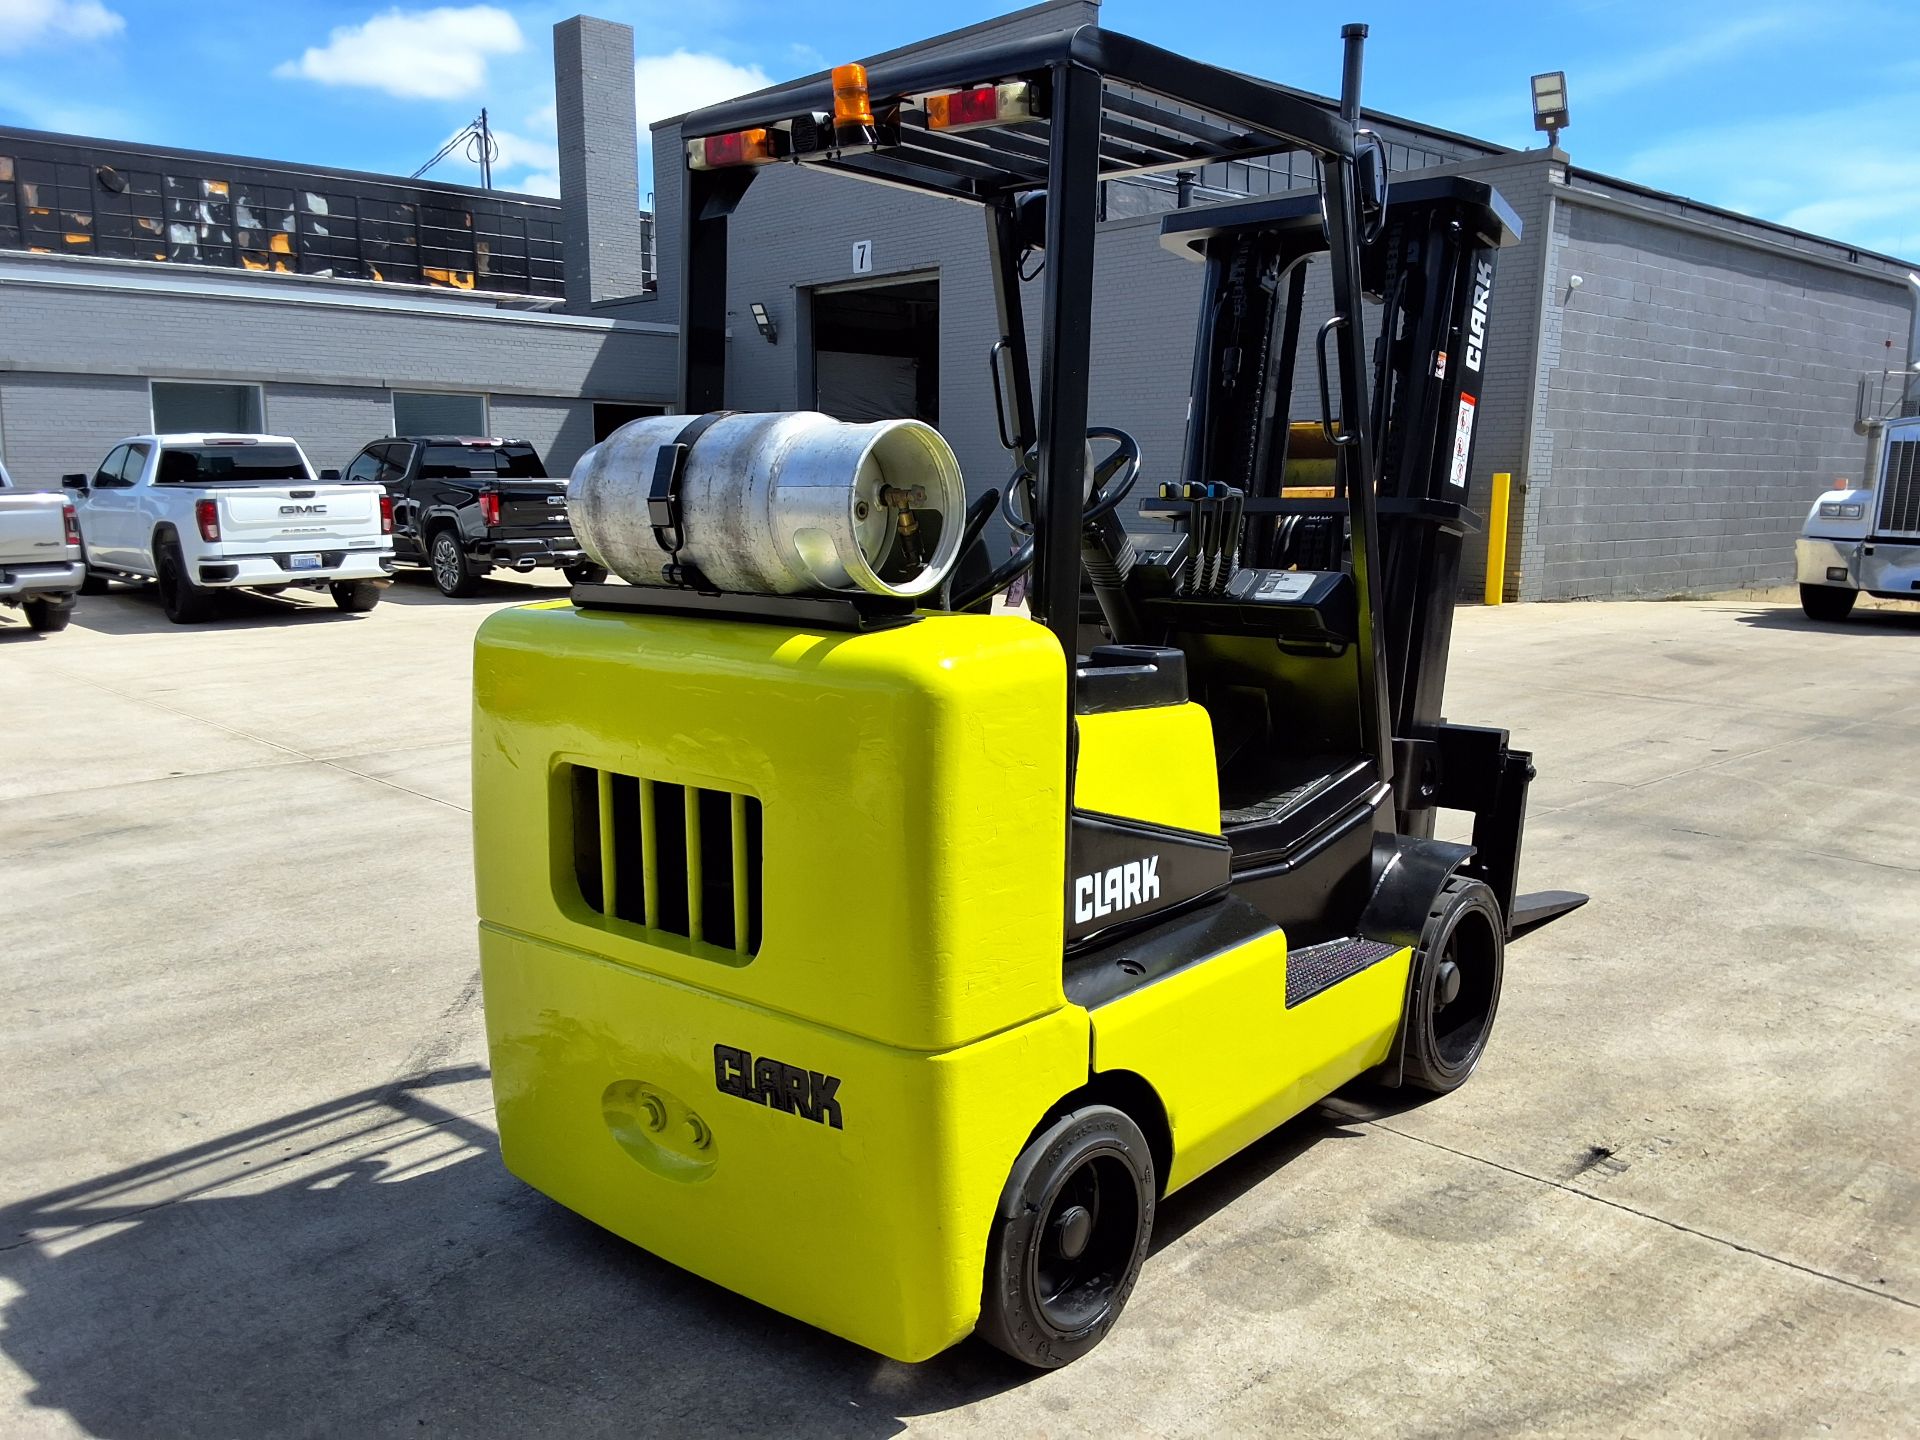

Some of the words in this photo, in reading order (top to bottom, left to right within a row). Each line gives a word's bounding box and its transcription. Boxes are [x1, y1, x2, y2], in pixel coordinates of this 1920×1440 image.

[857, 244, 867, 269] 7
[1465, 259, 1493, 373] CLARK
[279, 504, 328, 515] GMC
[1075, 854, 1160, 925] CLARK
[713, 1043, 844, 1131] CLARK
